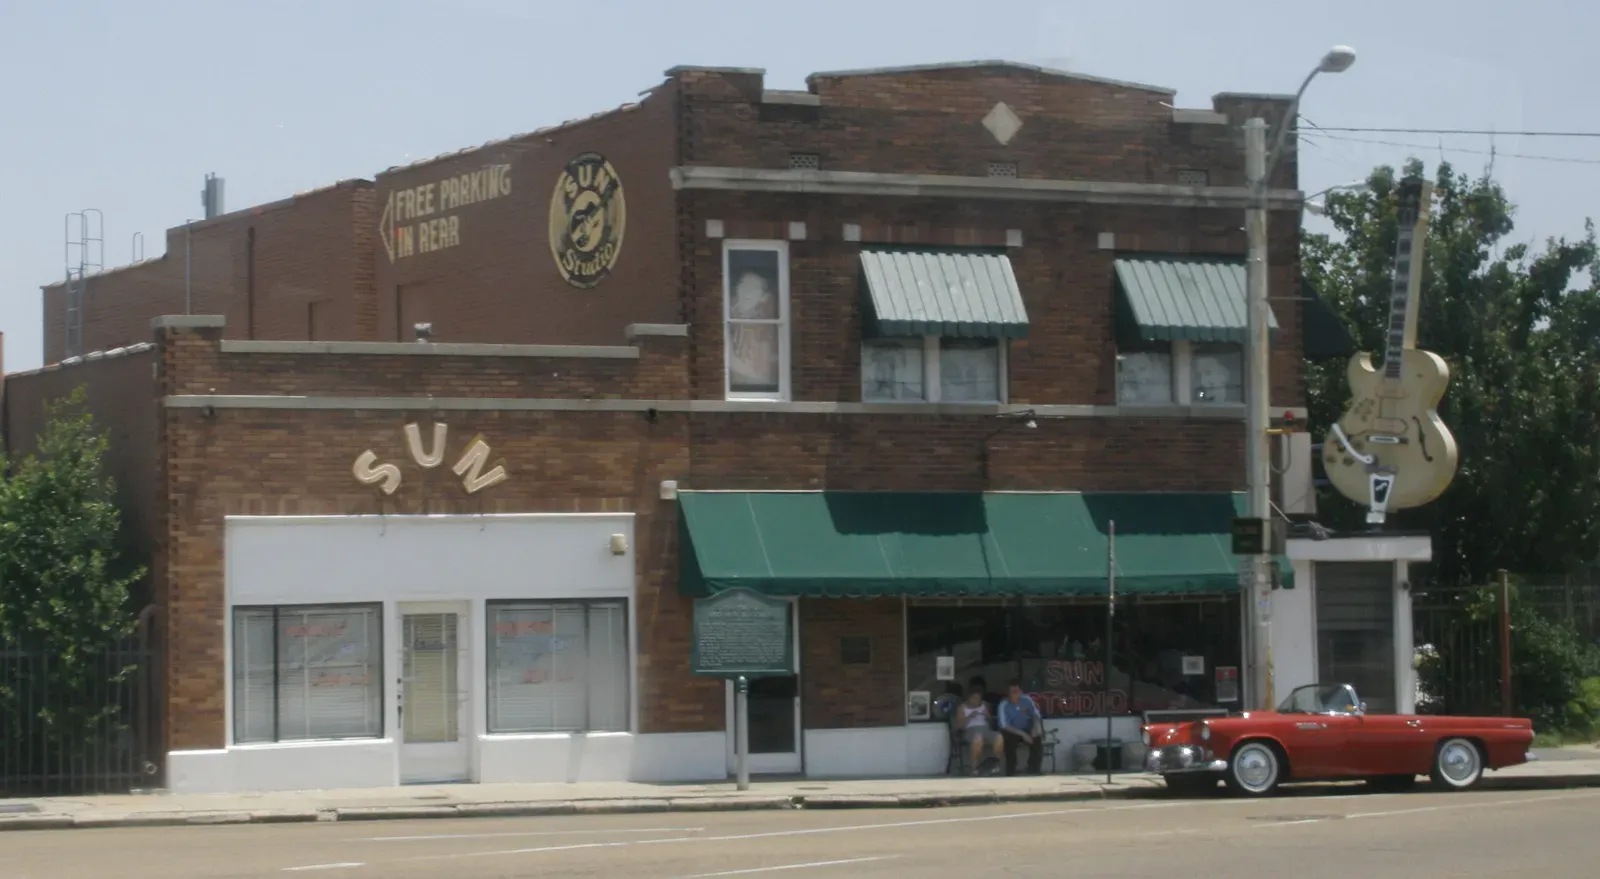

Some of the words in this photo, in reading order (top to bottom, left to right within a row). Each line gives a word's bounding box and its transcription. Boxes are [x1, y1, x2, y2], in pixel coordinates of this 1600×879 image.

[396, 183, 435, 221] FREE
[441, 164, 511, 211] PARKING
[564, 164, 611, 198] SUN
[397, 226, 413, 257] IN
[420, 216, 459, 252] REAR
[562, 242, 614, 276] Studio
[353, 422, 507, 495] SUN
[1046, 660, 1105, 686] SUN
